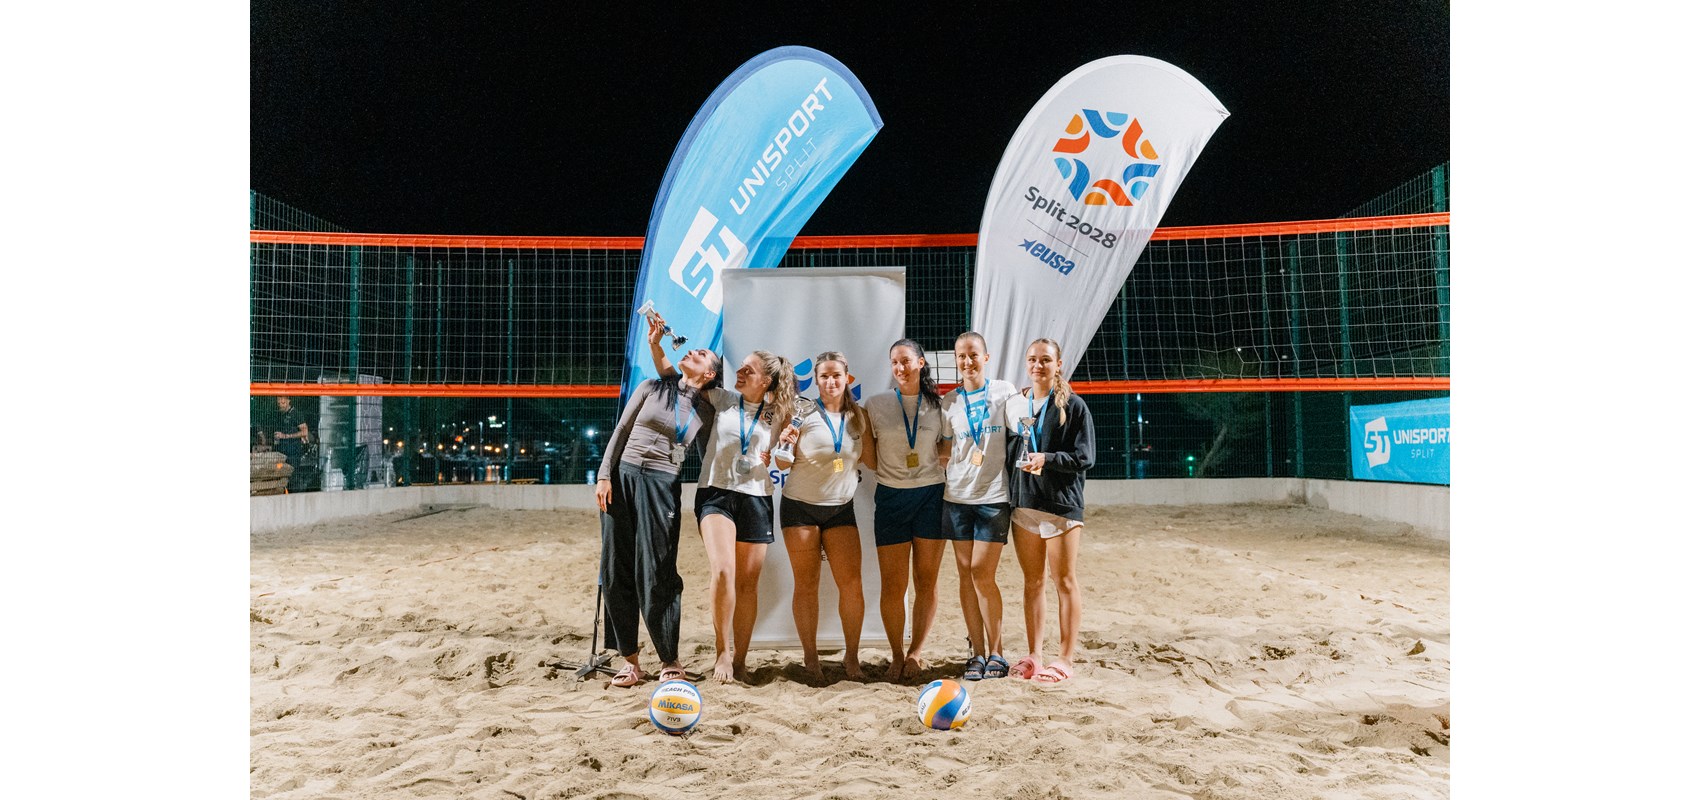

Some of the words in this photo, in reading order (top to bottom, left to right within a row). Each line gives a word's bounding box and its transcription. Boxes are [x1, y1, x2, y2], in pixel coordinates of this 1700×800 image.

[729, 77, 834, 216] UNISPORT
[776, 137, 818, 191] SPLIT
[1024, 186, 1066, 222] Split
[1066, 215, 1117, 249] 2028
[1030, 242, 1076, 276] eusa
[1411, 449, 1434, 458] SPLIT
